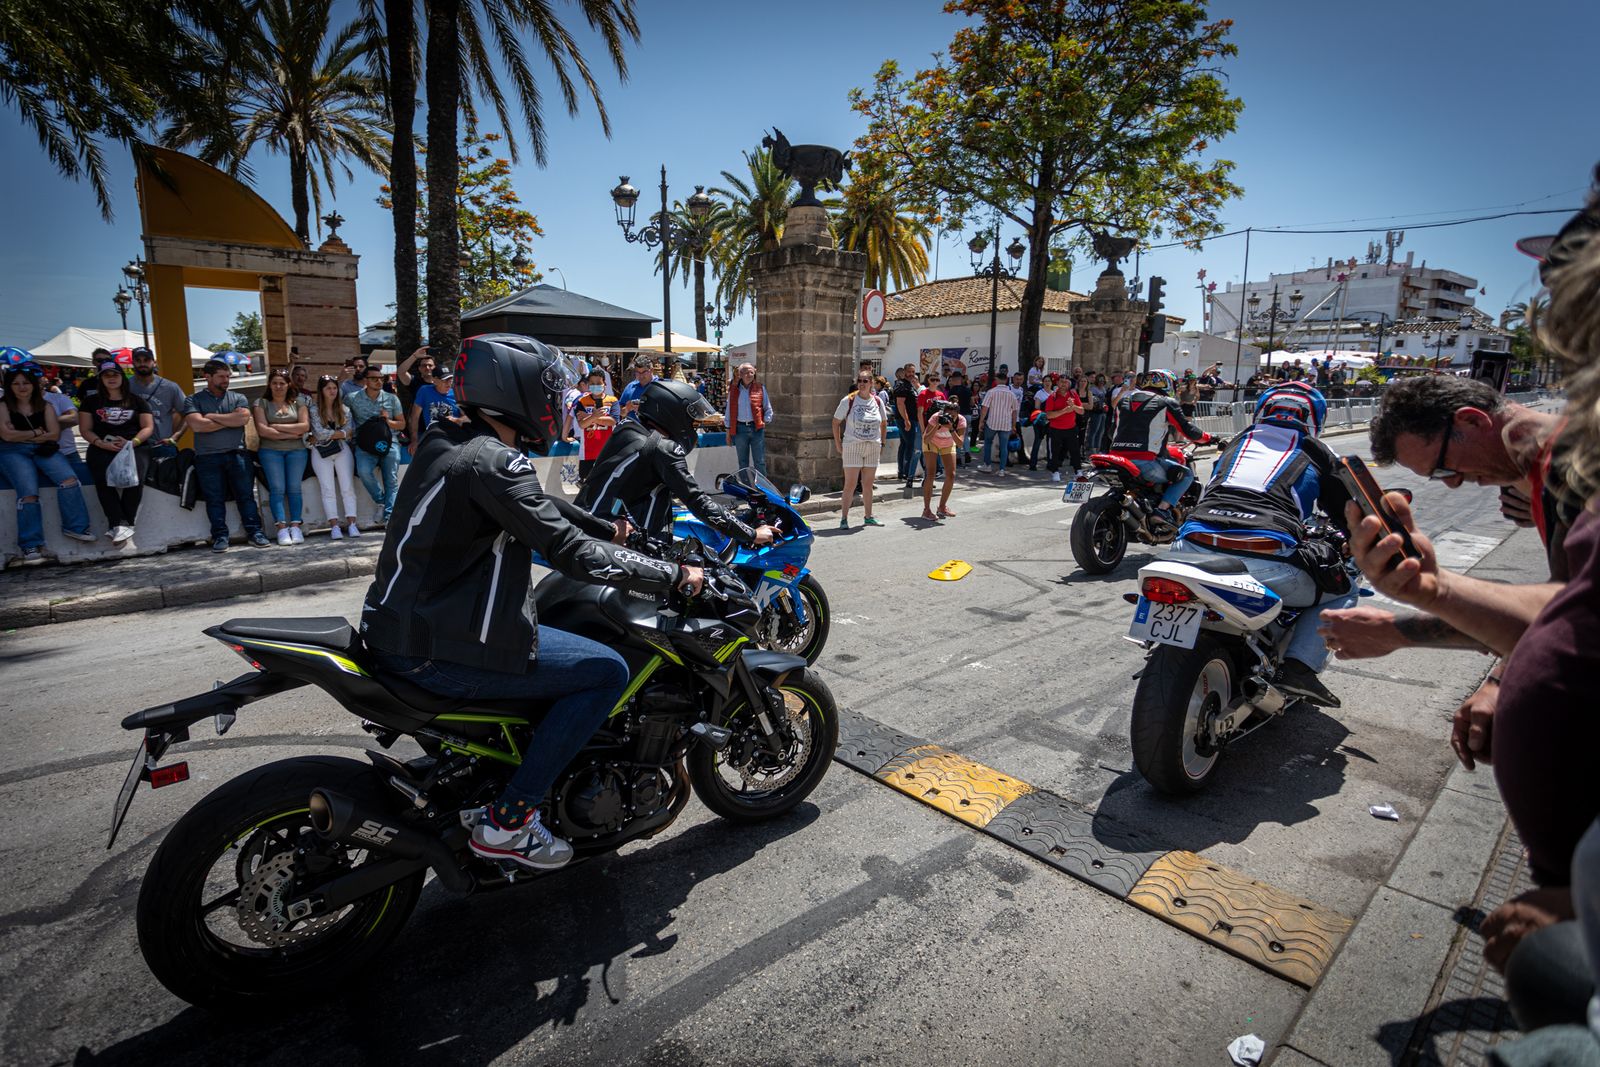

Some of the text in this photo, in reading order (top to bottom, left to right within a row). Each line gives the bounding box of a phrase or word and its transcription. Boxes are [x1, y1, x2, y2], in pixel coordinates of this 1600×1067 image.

[1069, 491, 1084, 500] KHK
[1072, 483, 1092, 492] 2309
[1152, 601, 1199, 624] 2377
[1150, 620, 1183, 643] CJL
[357, 819, 400, 843] SC
